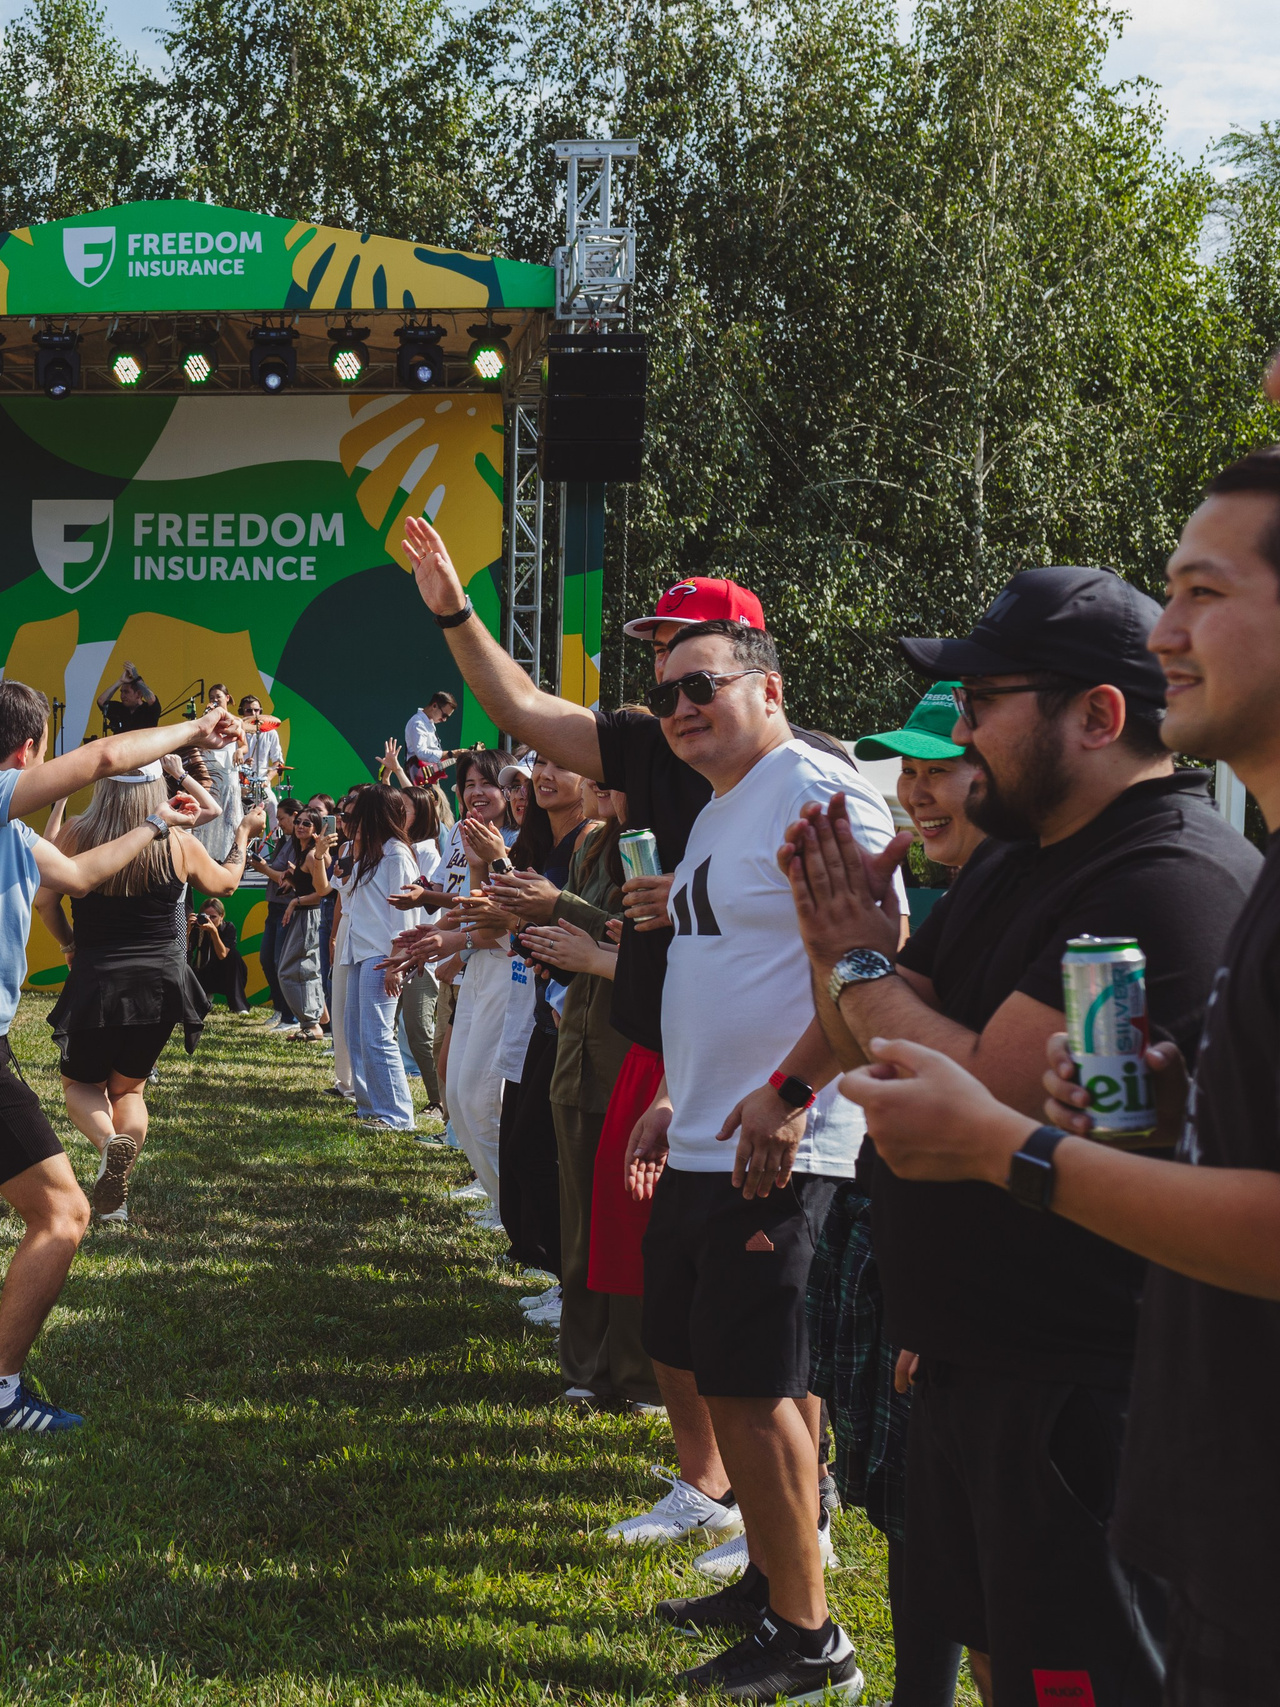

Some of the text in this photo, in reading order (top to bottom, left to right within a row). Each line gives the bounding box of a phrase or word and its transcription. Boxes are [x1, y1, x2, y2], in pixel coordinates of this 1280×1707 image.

[127, 231, 263, 256] FREEDOM
[128, 258, 245, 277] INSURANCE
[133, 512, 346, 548] FREEDOM
[133, 555, 317, 581] INSURANCE
